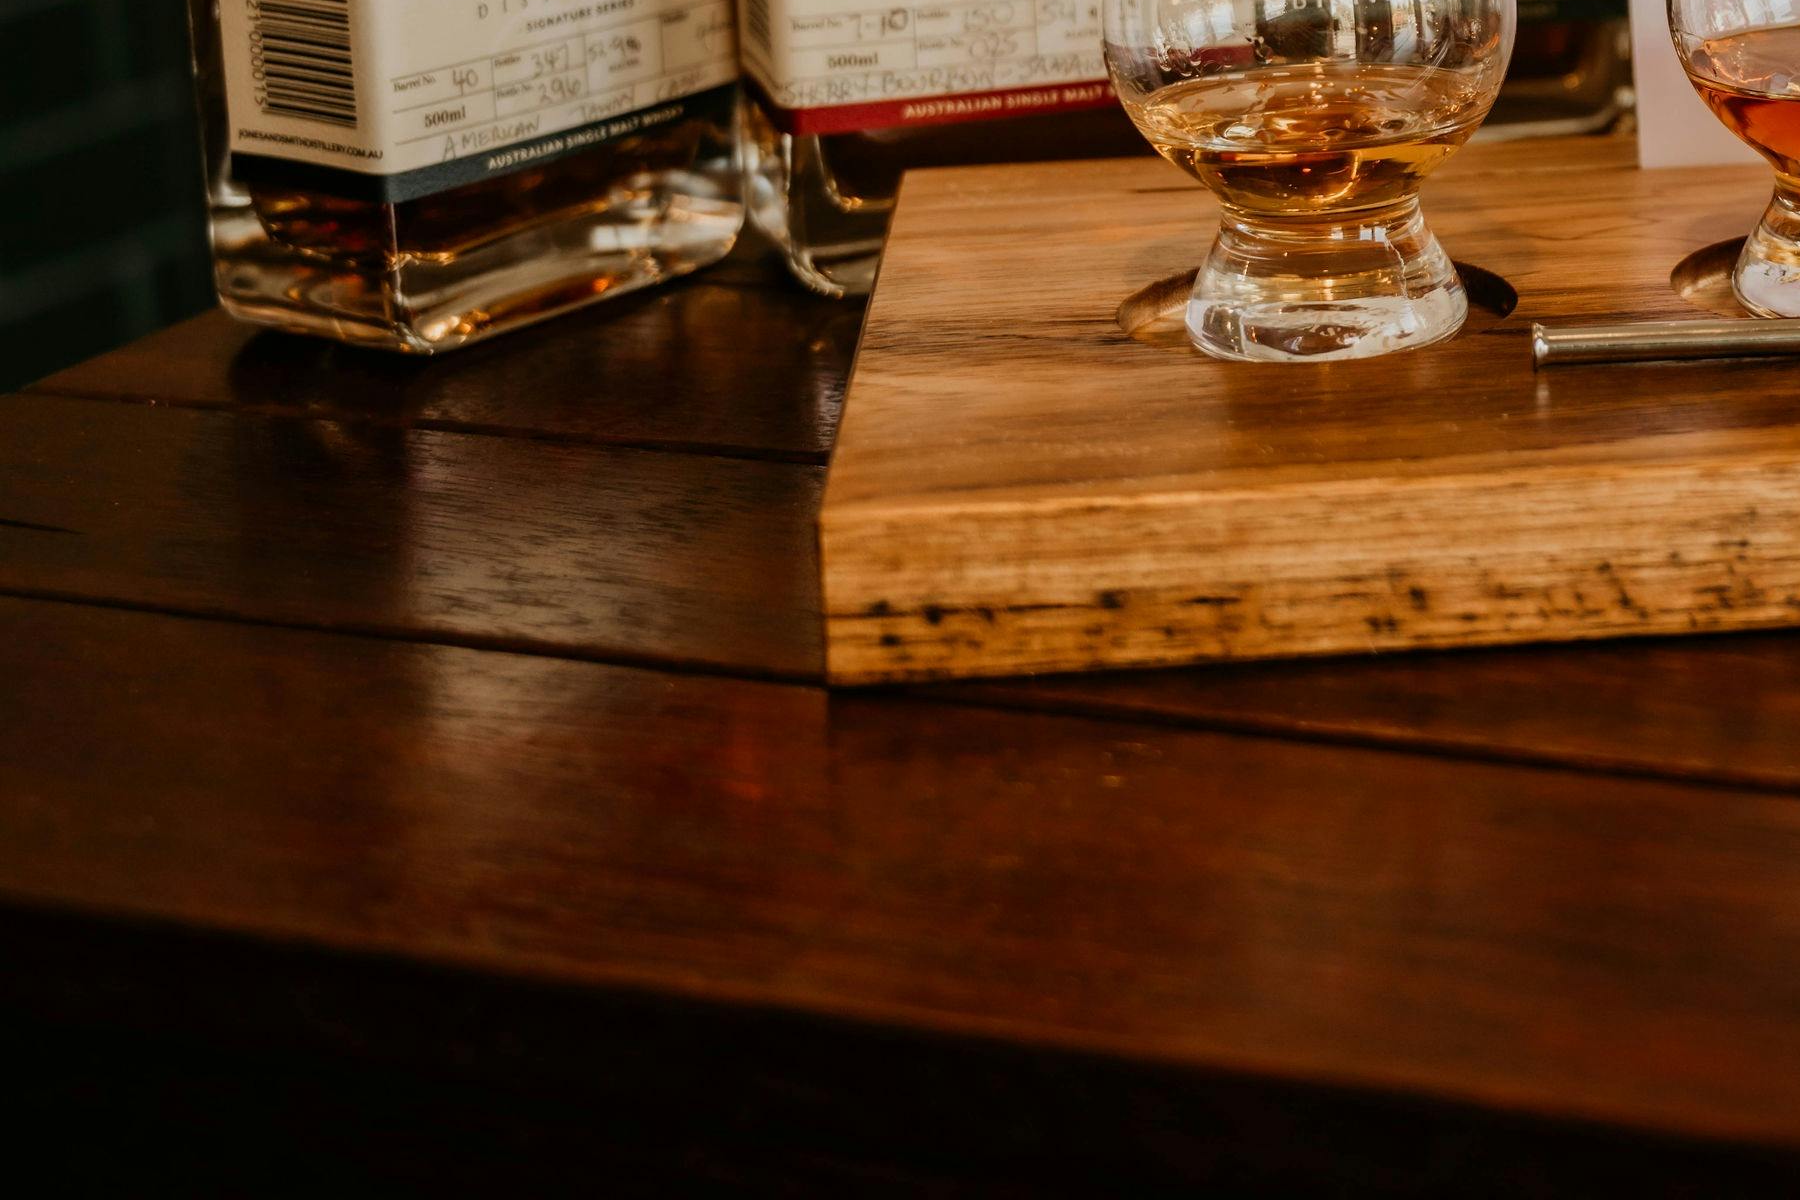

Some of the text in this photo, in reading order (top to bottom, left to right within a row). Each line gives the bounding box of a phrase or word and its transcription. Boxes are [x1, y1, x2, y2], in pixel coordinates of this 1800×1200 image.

[527, 6, 592, 32] SIGNATURE
[827, 52, 879, 69] 500ml
[452, 68, 479, 96] 40
[904, 96, 1003, 119] AUSTRALIAN
[1007, 90, 1058, 109] SINGLE
[1062, 84, 1103, 102] MALT
[424, 105, 467, 128] 500ml
[488, 136, 563, 171] AUSTRALIAN
[566, 126, 607, 149] SINGLE
